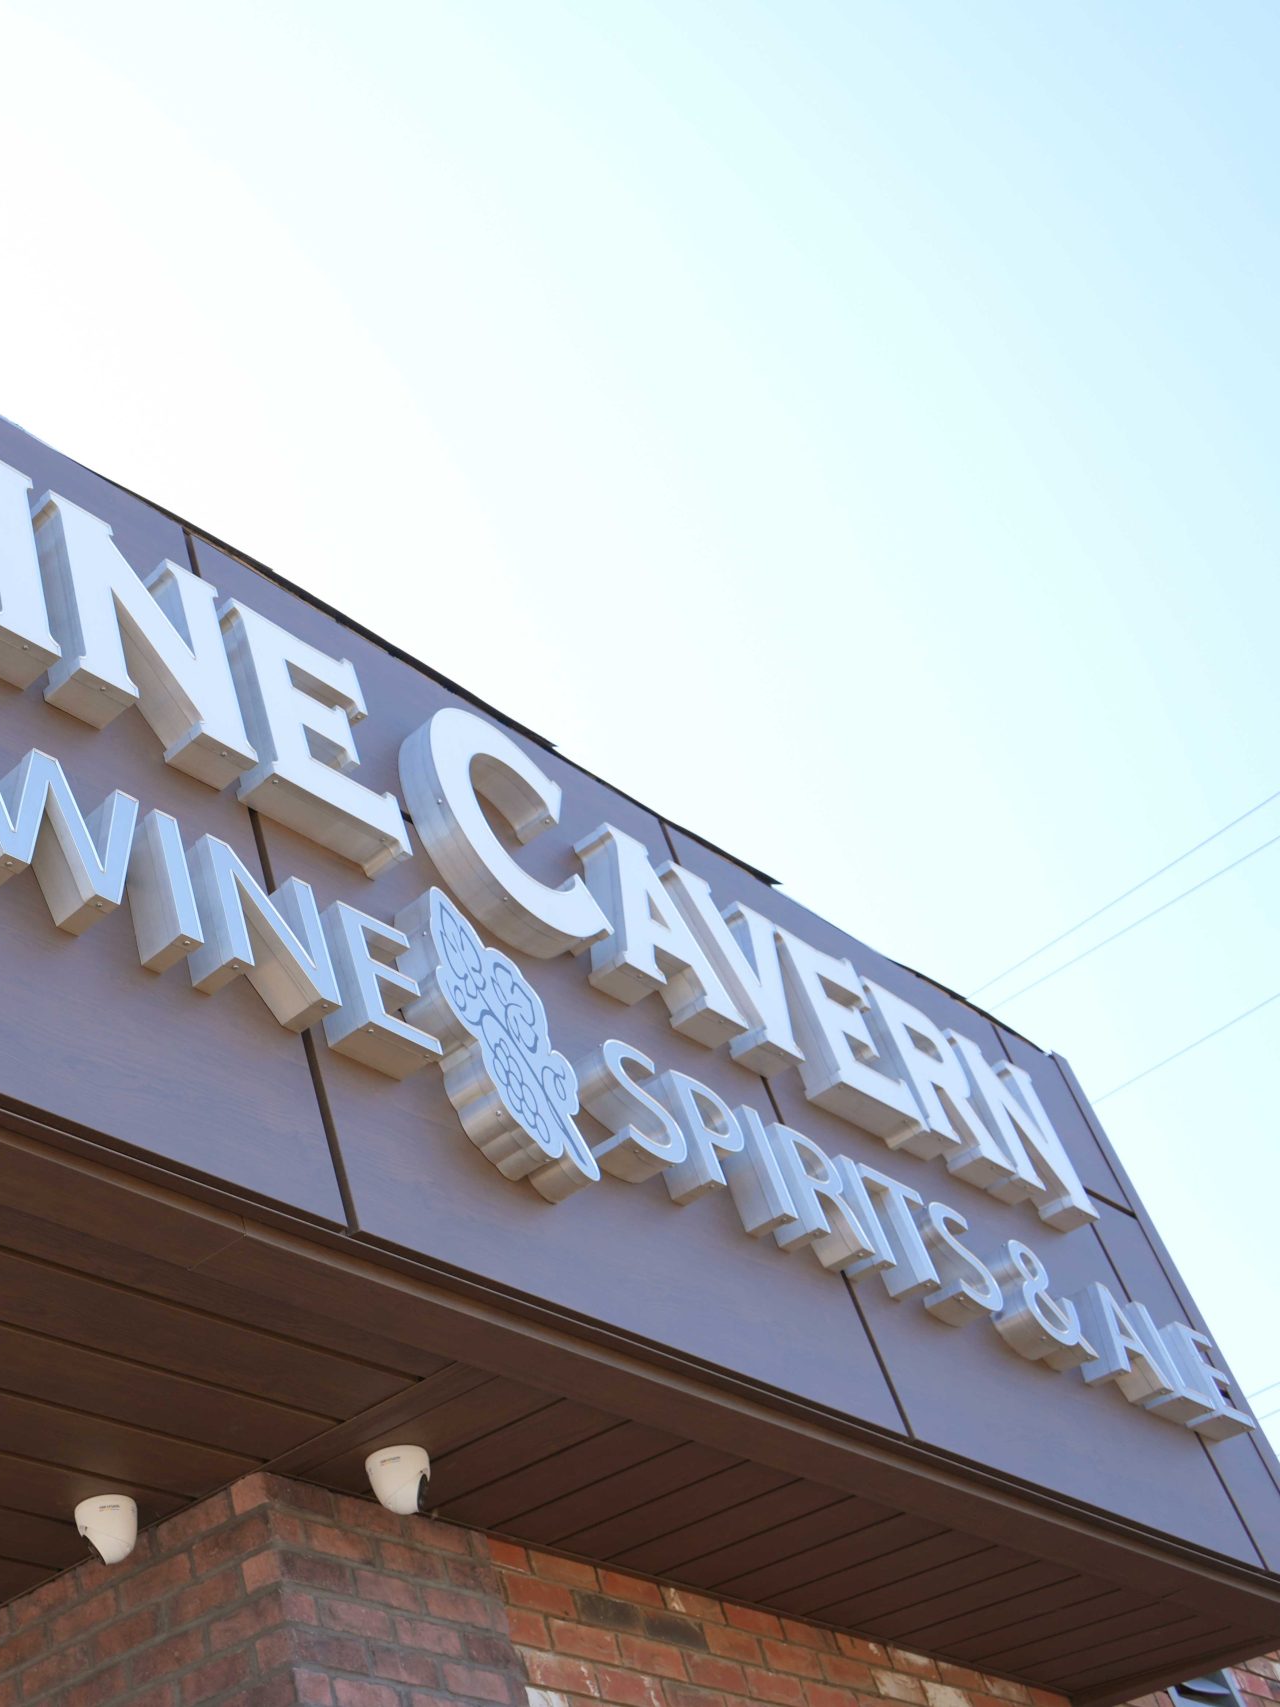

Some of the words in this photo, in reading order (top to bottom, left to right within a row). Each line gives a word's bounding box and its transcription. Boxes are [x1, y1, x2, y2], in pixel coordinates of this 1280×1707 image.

[426, 706, 1101, 1221] CAVERN
[602, 1038, 1004, 1312] SPIRITS
[1004, 1238, 1100, 1361] &
[1094, 1280, 1257, 1431] ALE
